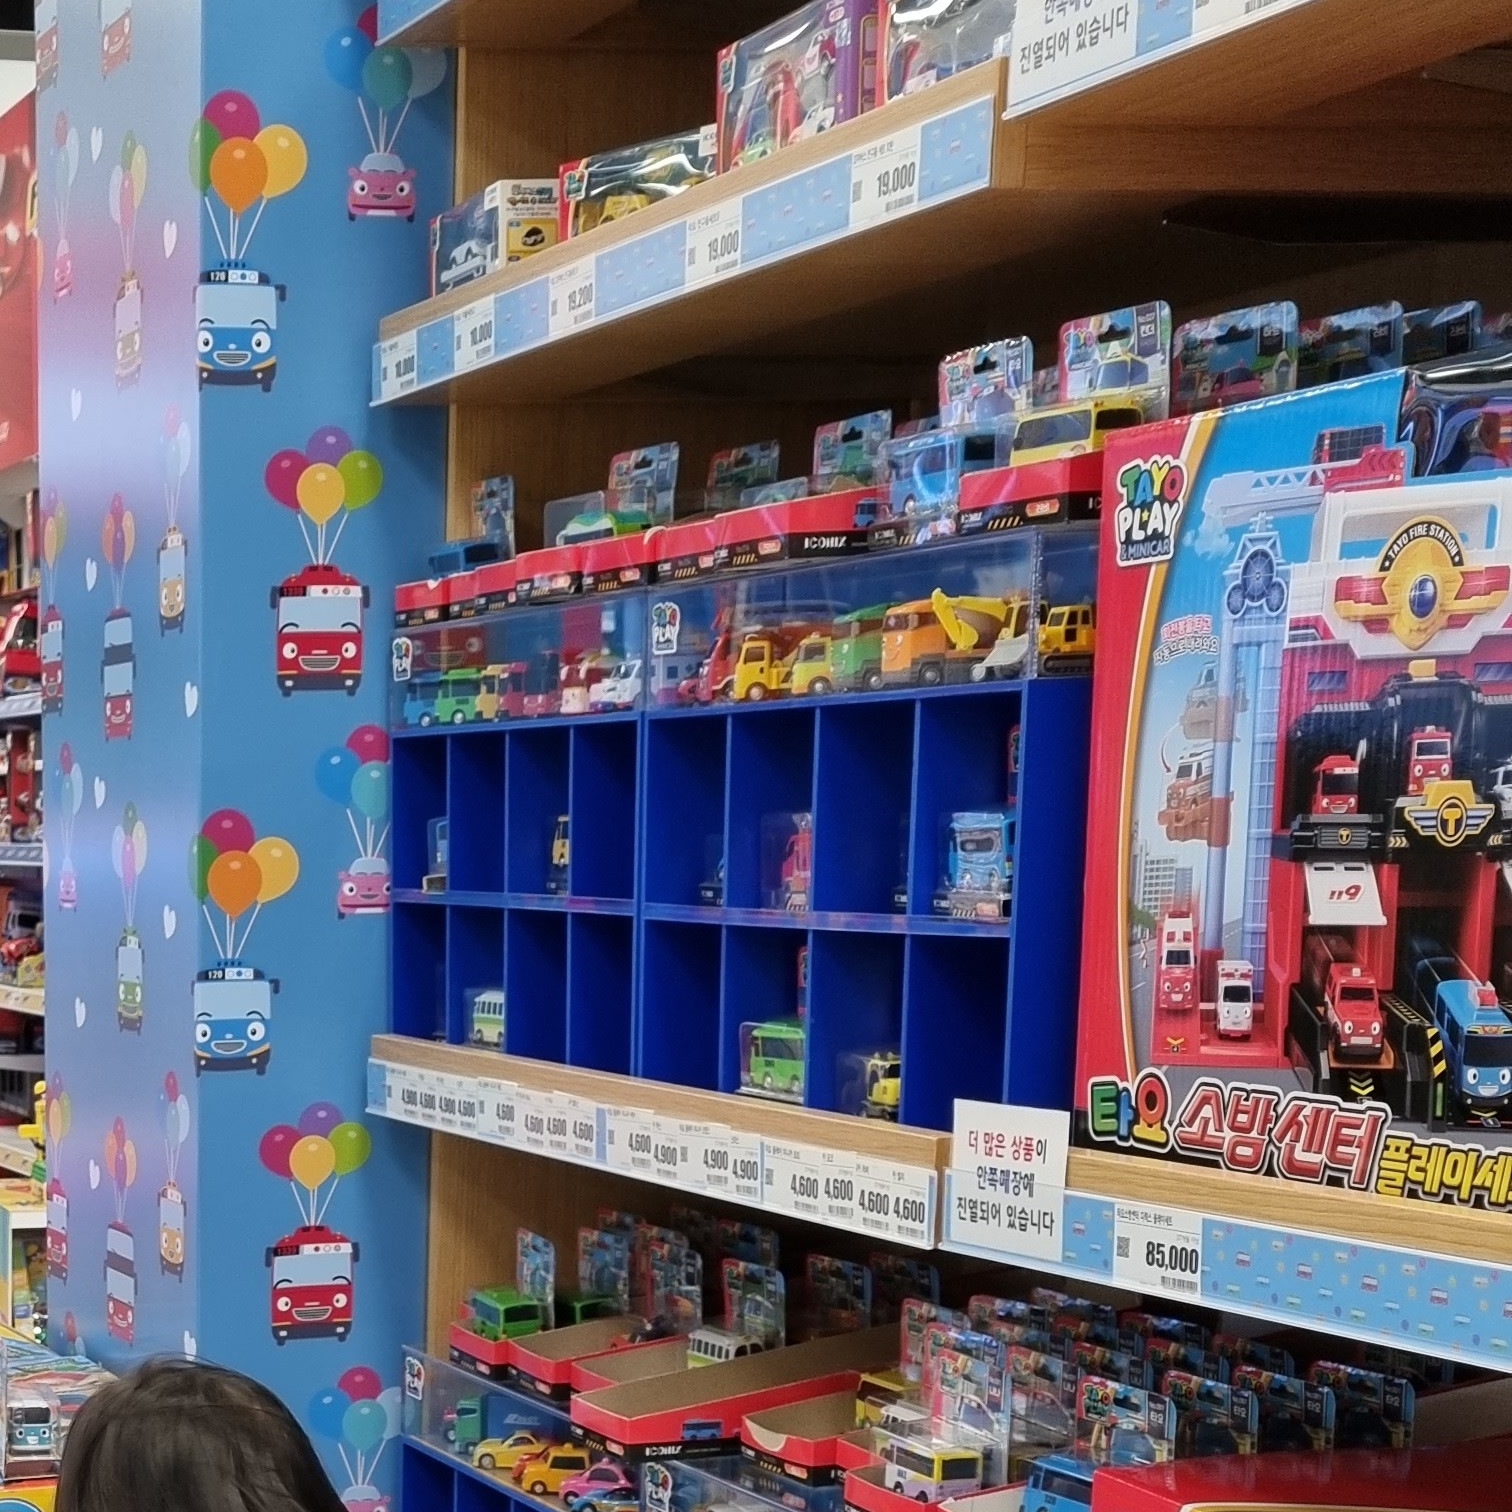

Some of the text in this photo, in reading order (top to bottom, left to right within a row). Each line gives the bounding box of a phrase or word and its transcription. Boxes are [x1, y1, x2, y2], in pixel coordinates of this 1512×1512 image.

[1019, 27, 1071, 75] 진열되어
[1075, 3, 1129, 52] 있습니다
[876, 162, 917, 198] 19,000
[707, 229, 740, 262] 19,000
[1118, 459, 1185, 507] TAYO
[1117, 500, 1183, 544] PLAY
[804, 535, 847, 549] ICONIX
[1387, 522, 1460, 561] TAYO FIRE STATION
[546, 1116, 567, 1138] 4,600
[572, 1119, 594, 1143] 4,600
[1090, 1077, 1168, 1143] 타요
[1176, 1086, 1385, 1187] 소방센터
[628, 1132, 652, 1155] 4,600
[653, 1143, 678, 1167] 4,900
[968, 1130, 1047, 1165] 더 많은 상품이
[703, 1148, 729, 1171] 4,900
[732, 1158, 759, 1182] 4,900
[790, 1173, 819, 1200] 4,600
[824, 1177, 853, 1202] 4,600
[976, 1165, 1035, 1198] 안쪽매장에
[858, 1189, 890, 1216] 4,600
[893, 1196, 925, 1225] 4,600
[956, 1196, 1055, 1237] 진열되어 있습니다
[1145, 1240, 1200, 1275] 85,000
